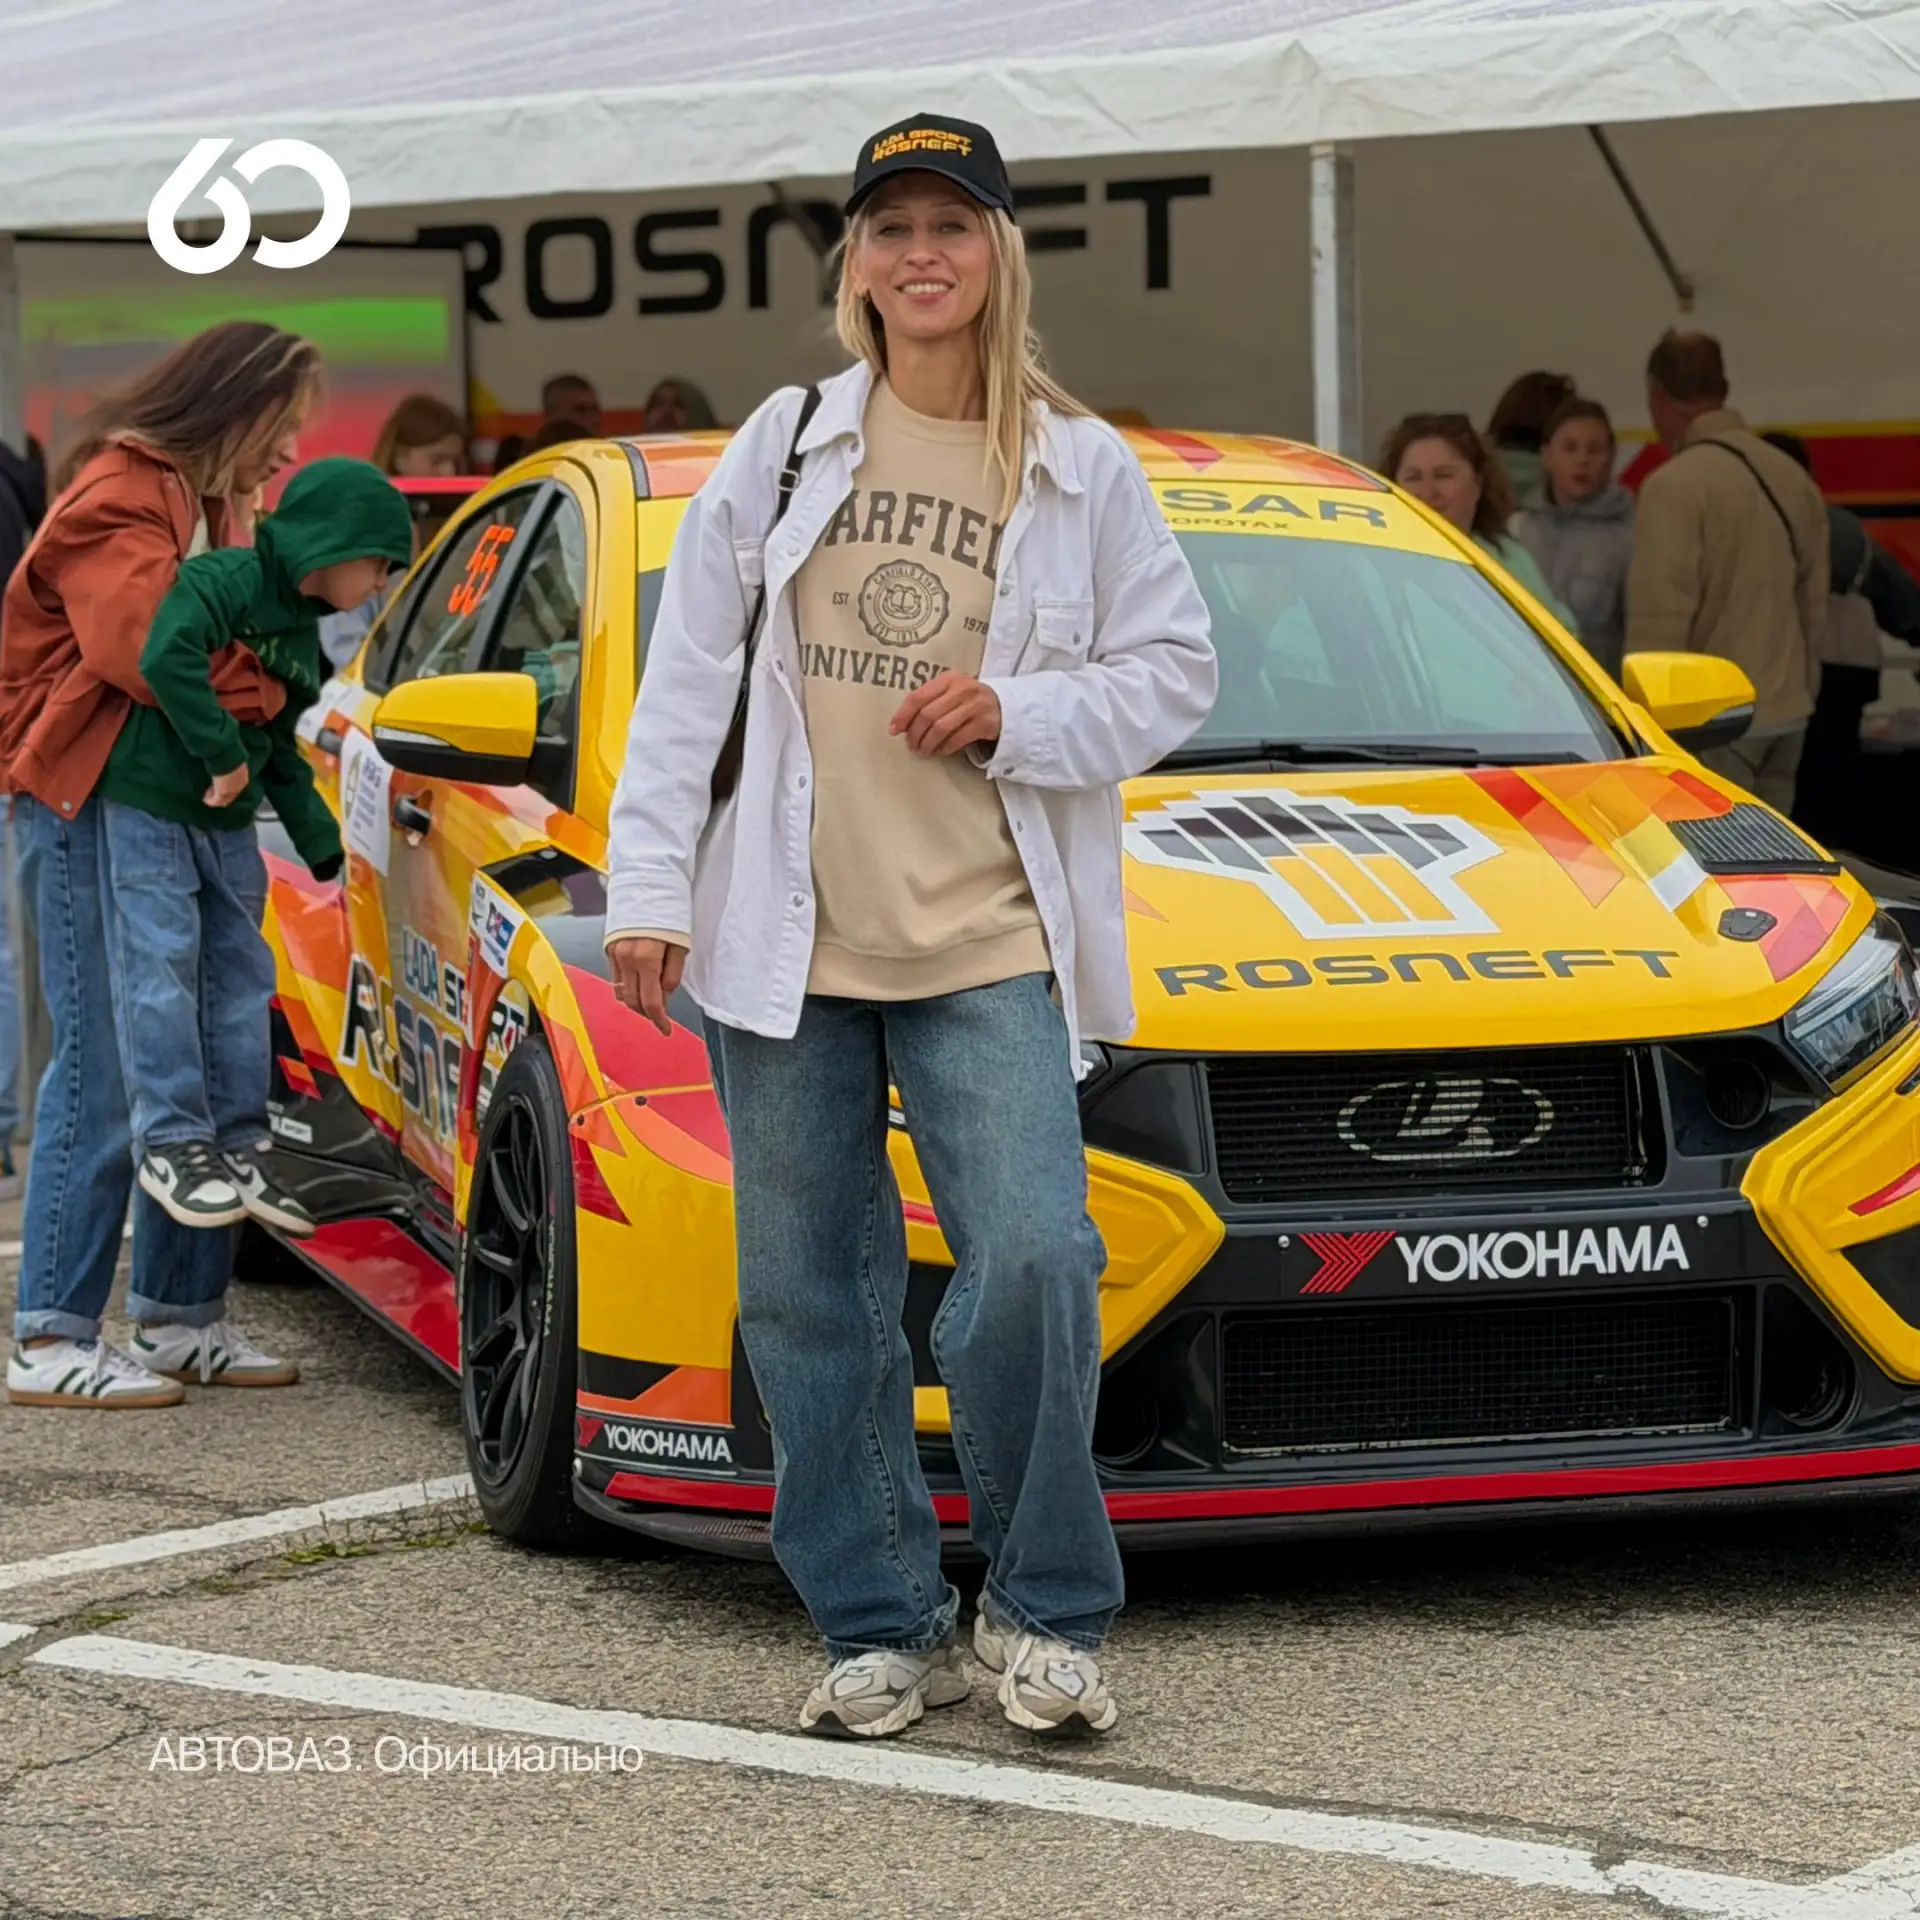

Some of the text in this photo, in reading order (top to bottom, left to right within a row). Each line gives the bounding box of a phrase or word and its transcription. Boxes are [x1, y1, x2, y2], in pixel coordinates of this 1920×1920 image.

[1161, 488, 1388, 529] SAR
[832, 592, 850, 605] EST
[1153, 949, 1680, 997] ROSNEFT
[1395, 1223, 1690, 1284] YOKOHAMA
[604, 1423, 733, 1464] YOKOHAMA
